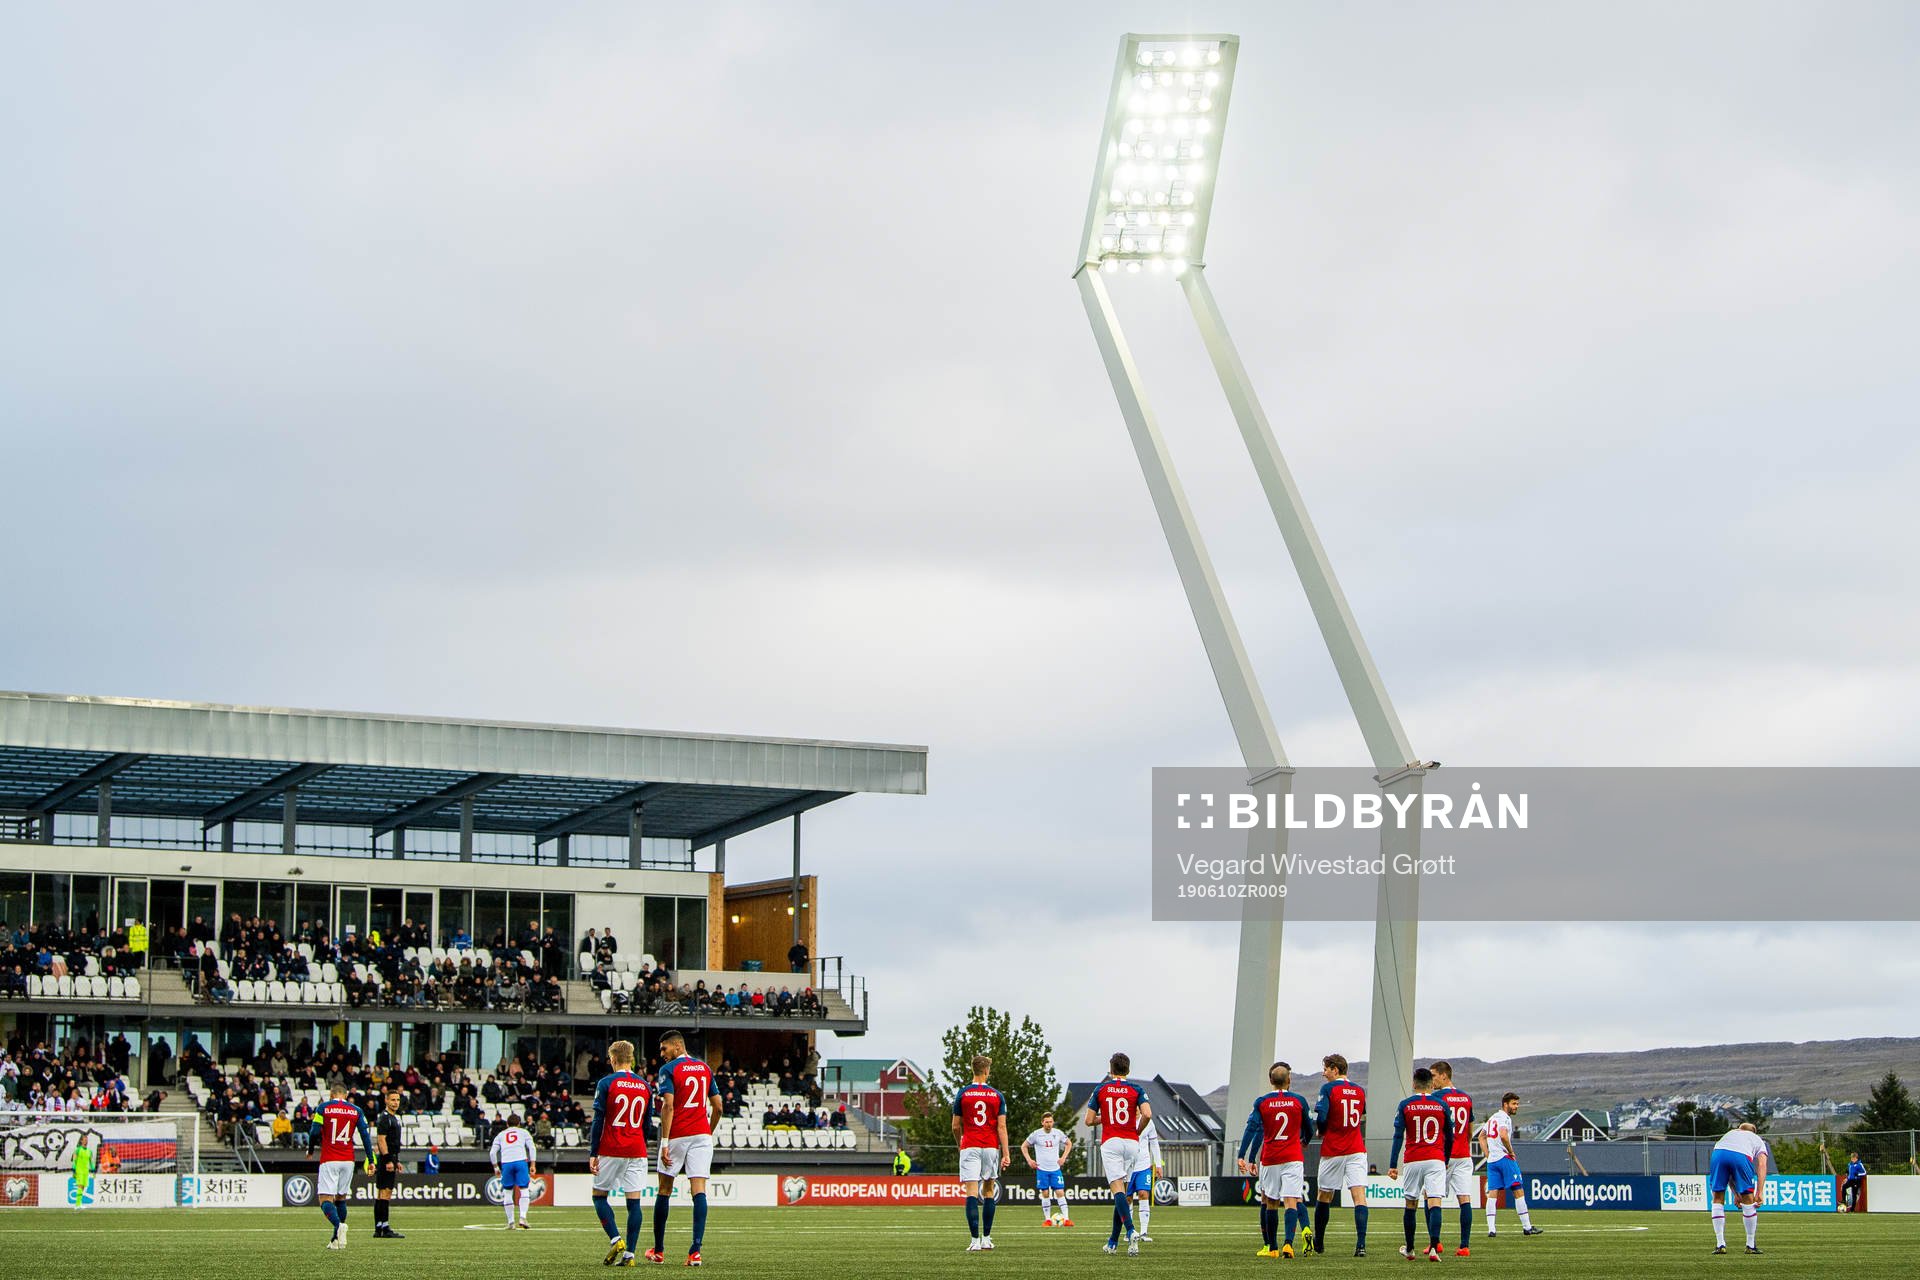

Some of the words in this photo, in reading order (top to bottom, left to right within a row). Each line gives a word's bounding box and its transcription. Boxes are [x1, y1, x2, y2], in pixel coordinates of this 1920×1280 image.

[616, 1080, 646, 1091] ØDEGAARD
[683, 1076, 708, 1109] 21
[612, 1093, 646, 1129] 20
[973, 1100, 987, 1127] 3
[1105, 1097, 1130, 1125] 18
[1340, 1099, 1361, 1128] 15
[330, 1118, 351, 1145] 14
[1274, 1111, 1289, 1141] 2
[1412, 1115, 1440, 1144] 10
[1487, 1119, 1499, 1139] 13
[505, 1131, 518, 1144] 6
[1045, 1140, 1053, 1148] 11
[98, 1178, 143, 1194] 支付宝
[204, 1178, 248, 1194] 支付宝
[390, 1182, 454, 1200] electric
[456, 1183, 481, 1199] ID.
[711, 1183, 732, 1197] TV
[811, 1183, 888, 1198] EUROPEAN
[891, 1183, 968, 1200] QUALIFIERS
[1006, 1185, 1036, 1200] The
[1180, 1182, 1209, 1192] UEFA
[1366, 1183, 1405, 1199] Hisens
[1531, 1178, 1632, 1206] Booking.com
[100, 1195, 142, 1203] ALIPAY
[205, 1195, 247, 1203] ALIPAY
